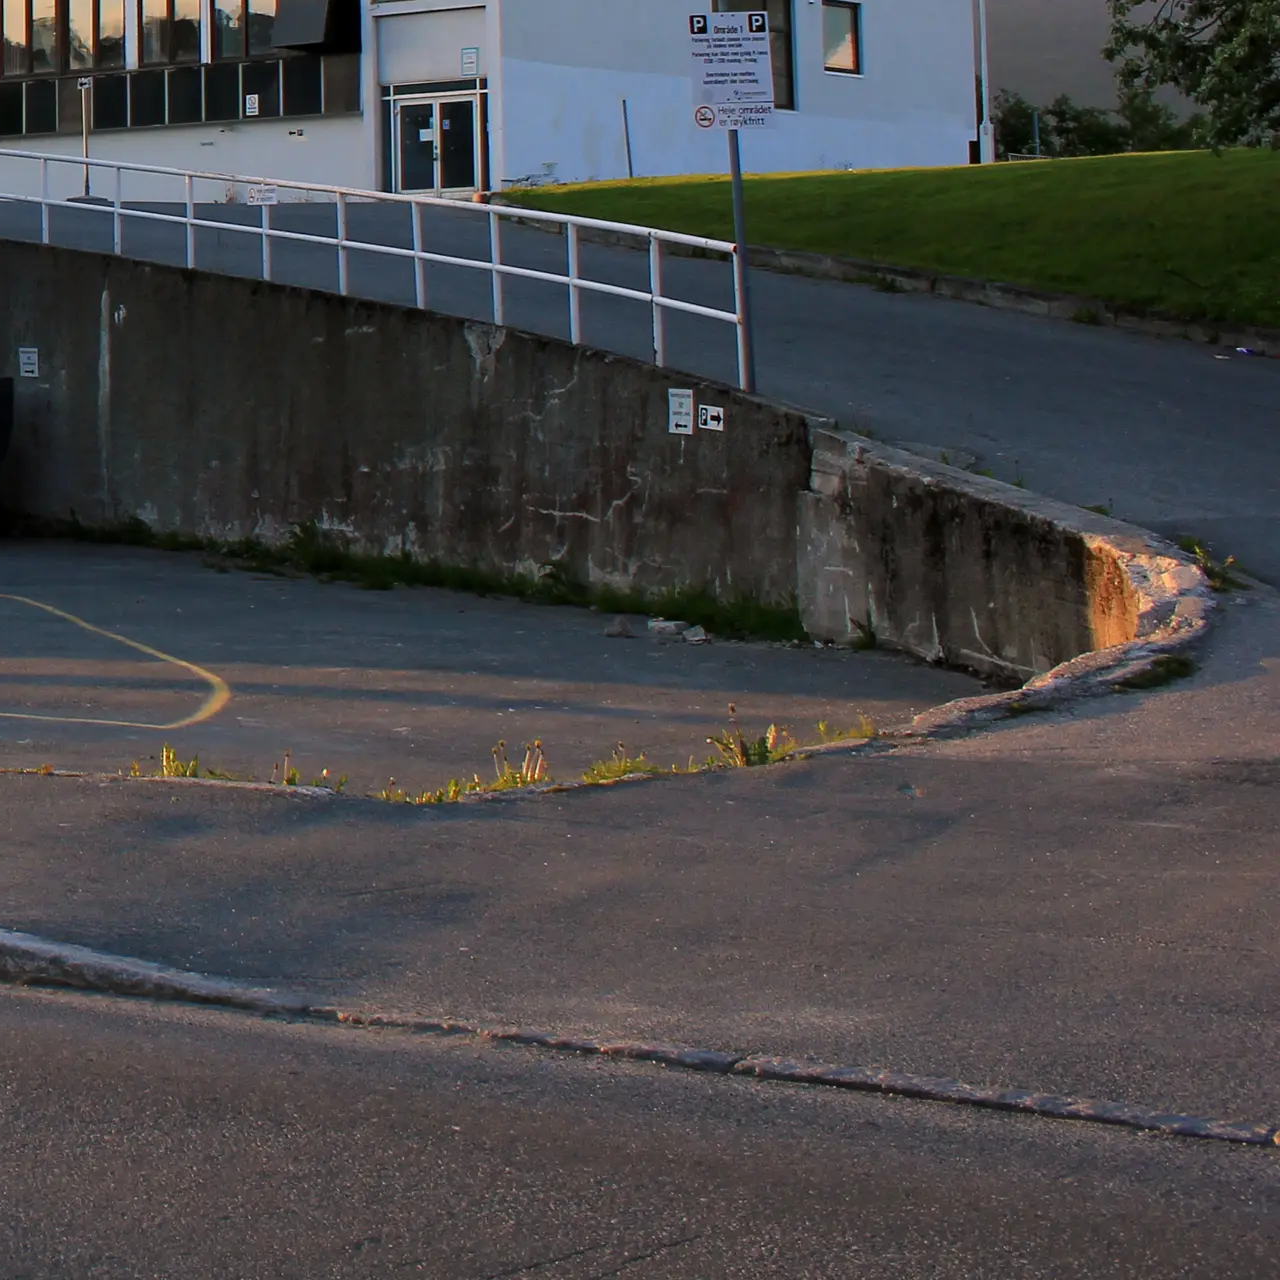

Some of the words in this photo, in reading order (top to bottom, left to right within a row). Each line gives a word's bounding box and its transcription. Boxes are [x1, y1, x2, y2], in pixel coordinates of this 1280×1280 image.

[693, 16, 704, 32] P
[751, 15, 763, 31] P
[738, 104, 772, 115] området
